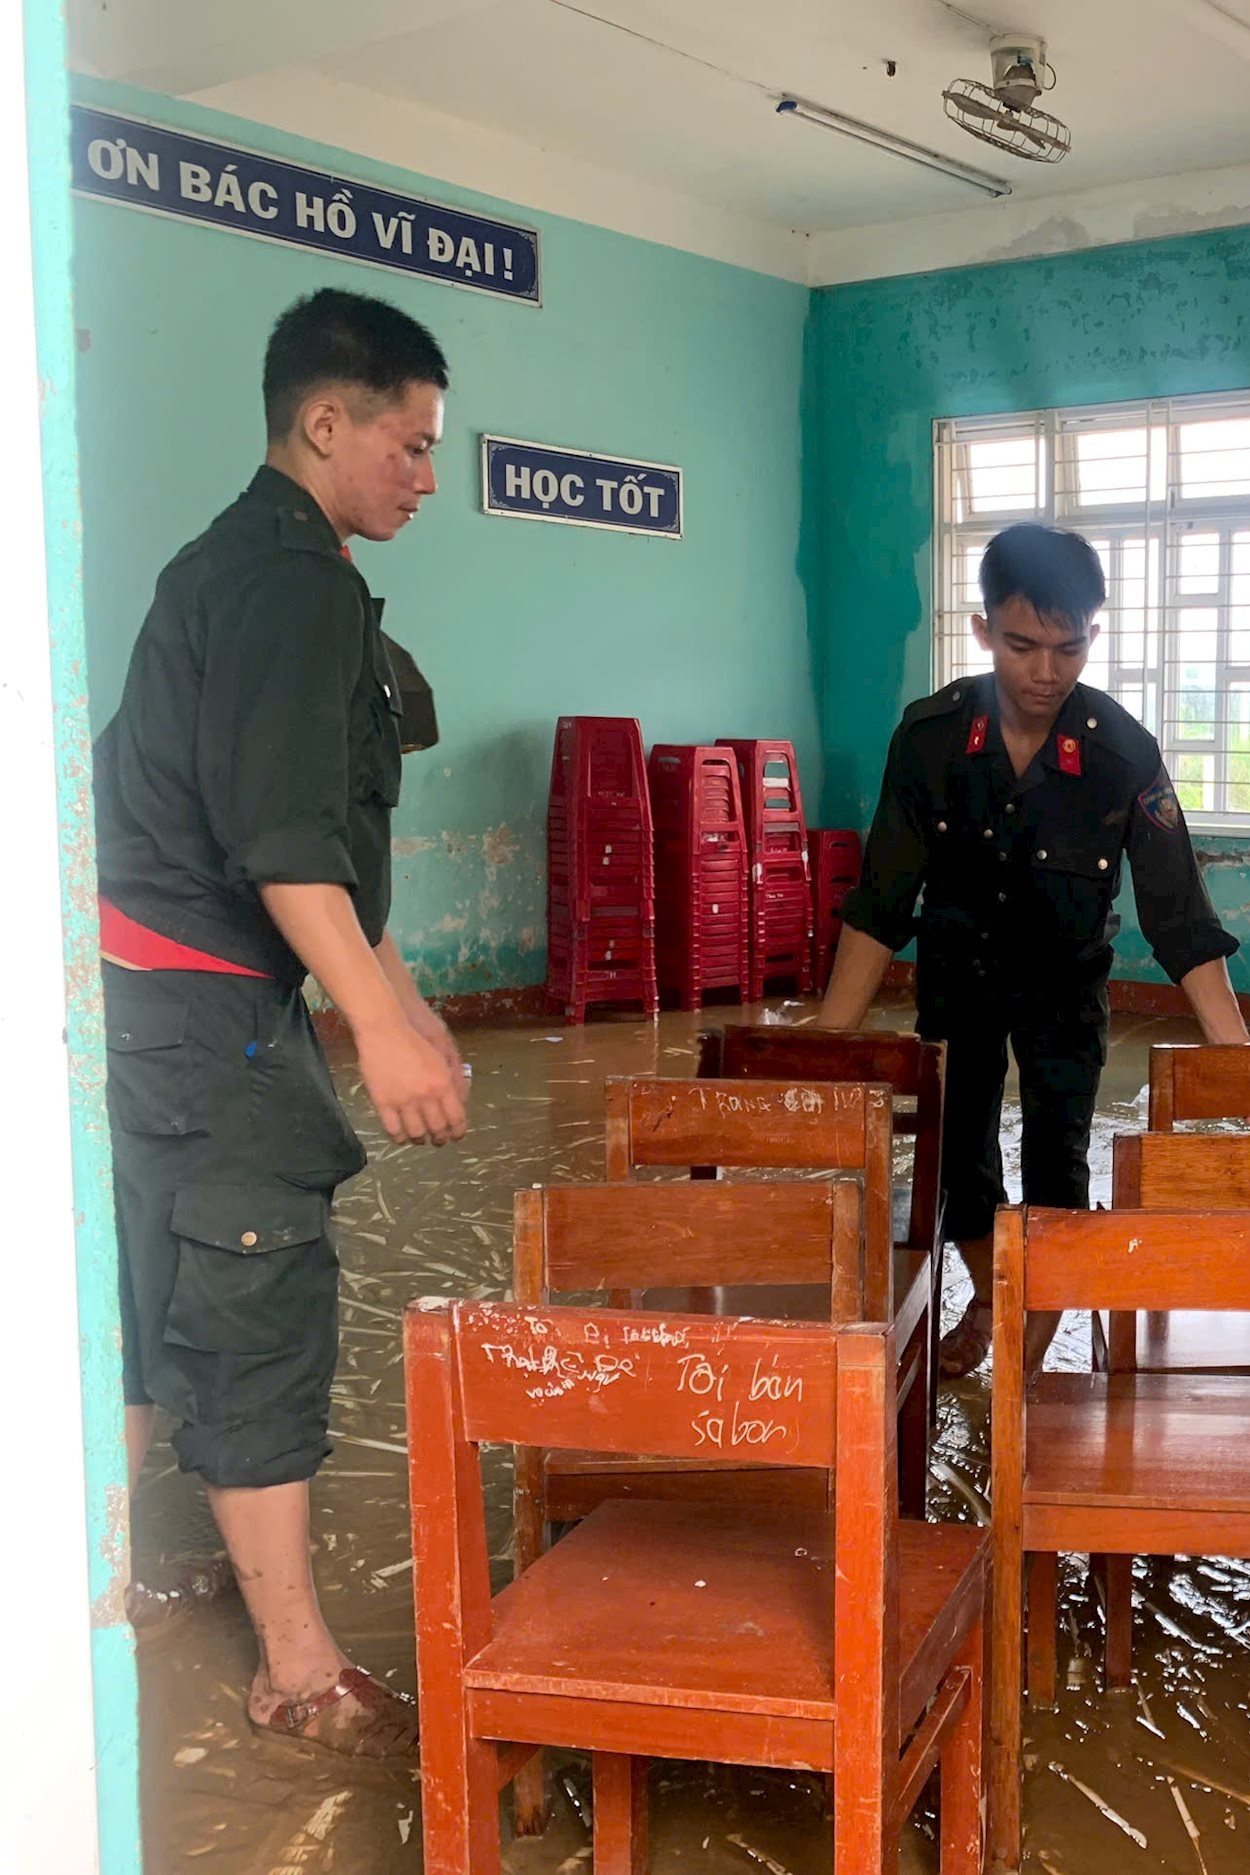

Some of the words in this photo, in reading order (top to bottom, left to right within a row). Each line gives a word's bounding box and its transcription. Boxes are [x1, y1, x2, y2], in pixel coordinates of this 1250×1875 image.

[87, 138, 161, 192] ƠN
[178, 164, 280, 220] BÁC
[295, 188, 358, 240] HỒ
[371, 210, 417, 256] VĨ
[505, 463, 585, 509] HỌC
[595, 473, 666, 518] TỐT
